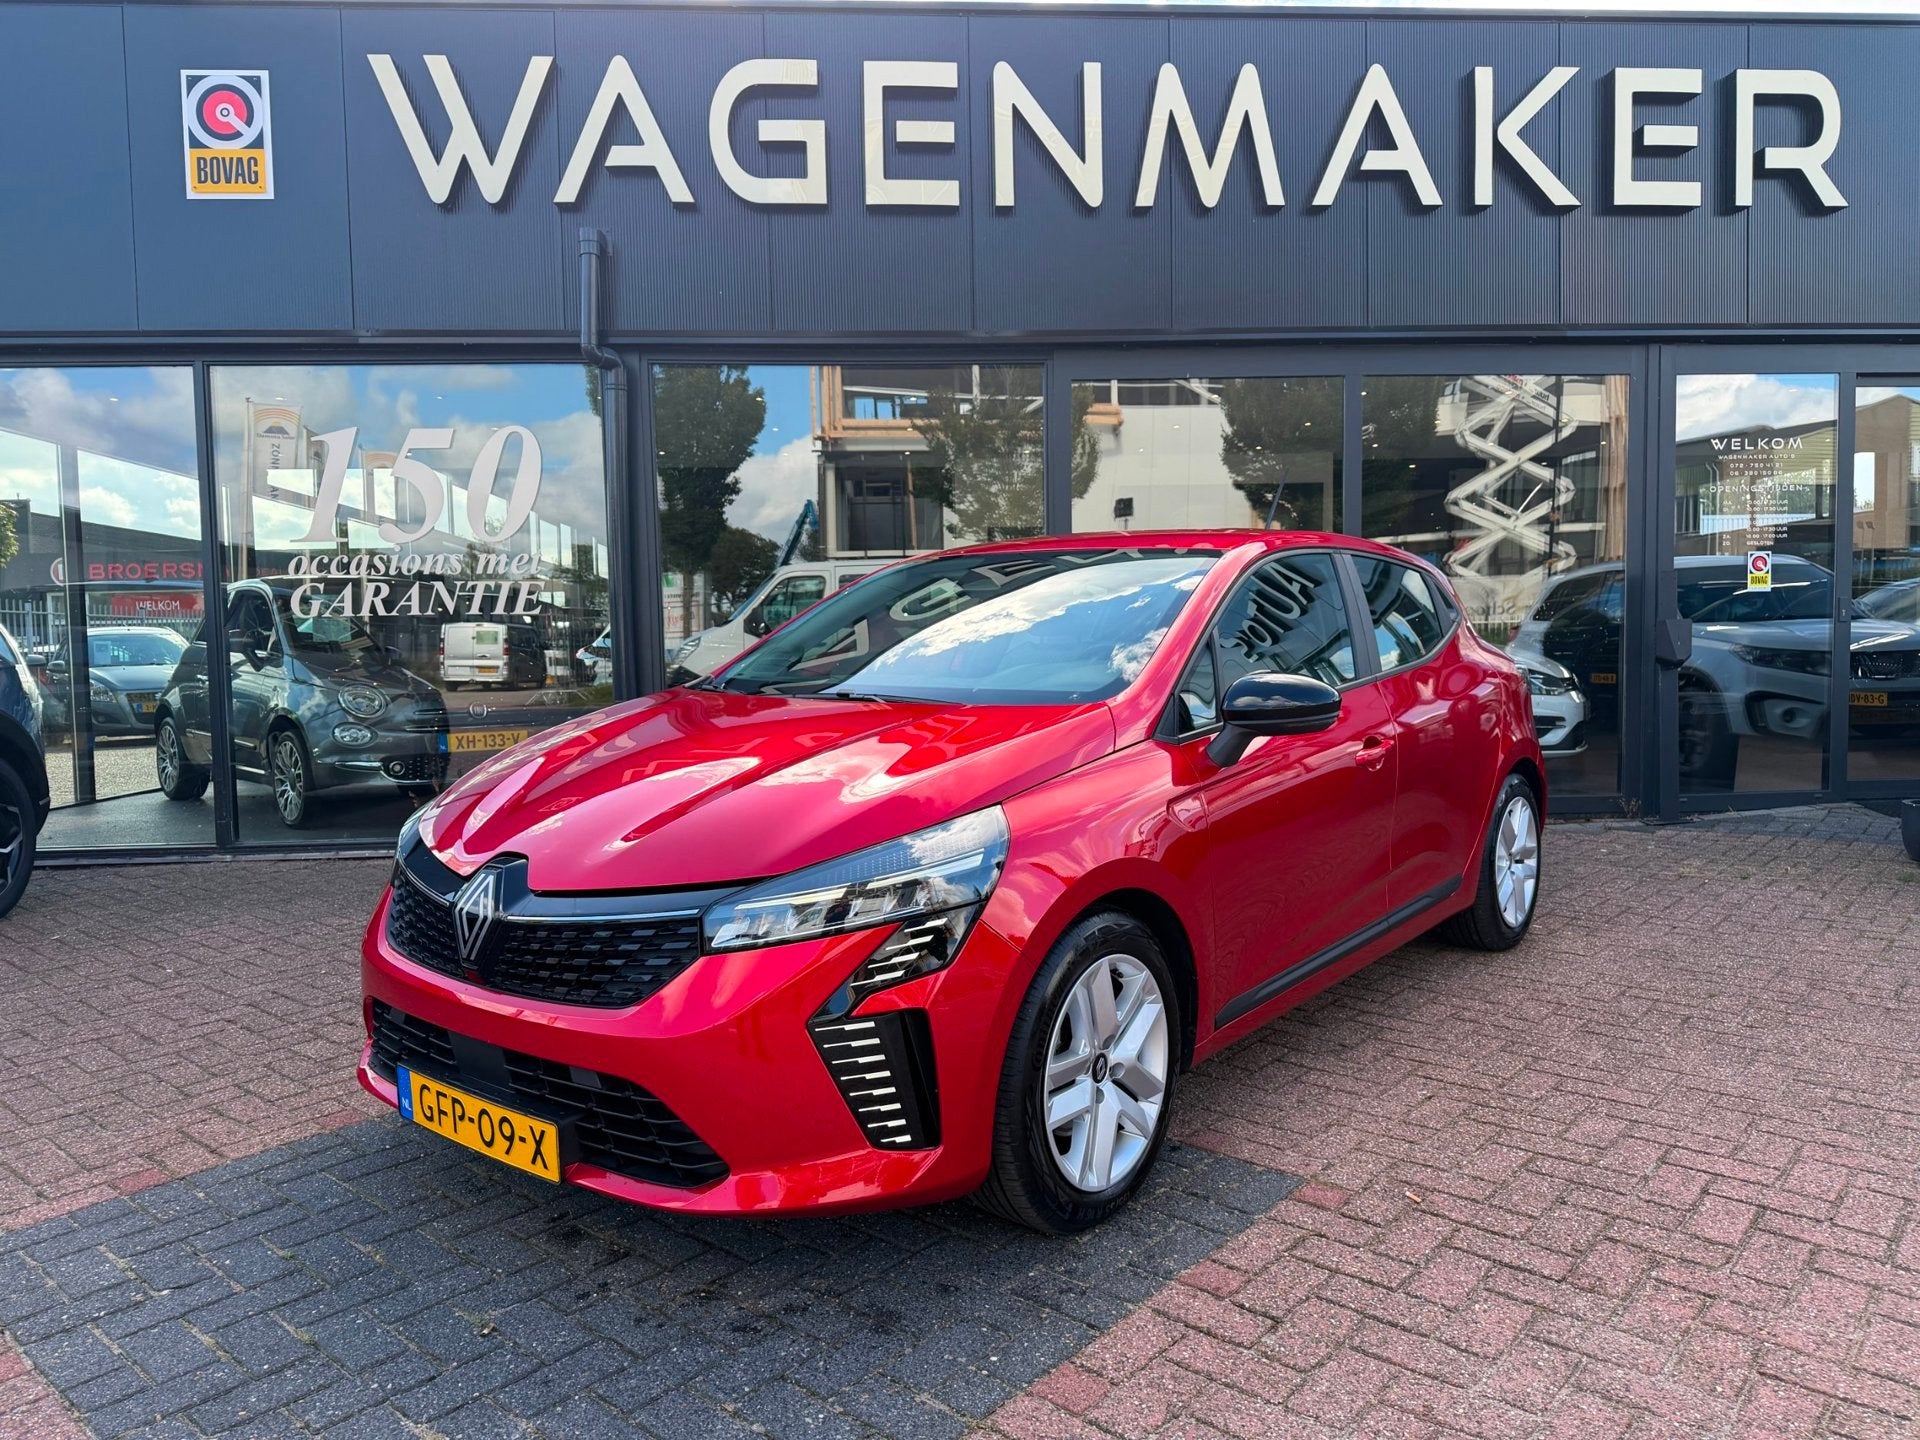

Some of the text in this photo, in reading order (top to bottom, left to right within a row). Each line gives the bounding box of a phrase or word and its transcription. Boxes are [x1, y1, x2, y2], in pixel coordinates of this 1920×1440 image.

[367, 53, 1848, 207] WAGENMAKER
[196, 156, 259, 185] BOVAG
[1710, 437, 1803, 450] WELKOM
[290, 425, 542, 544] 150
[288, 546, 543, 577] occasions met
[1750, 575, 1768, 585] BOVAG
[135, 600, 180, 612] WELKOM
[290, 580, 547, 617] GARANTIE
[455, 732, 521, 750] XH-133-V
[401, 1098, 412, 1111] NL
[419, 1083, 550, 1170] GFP-09-X
